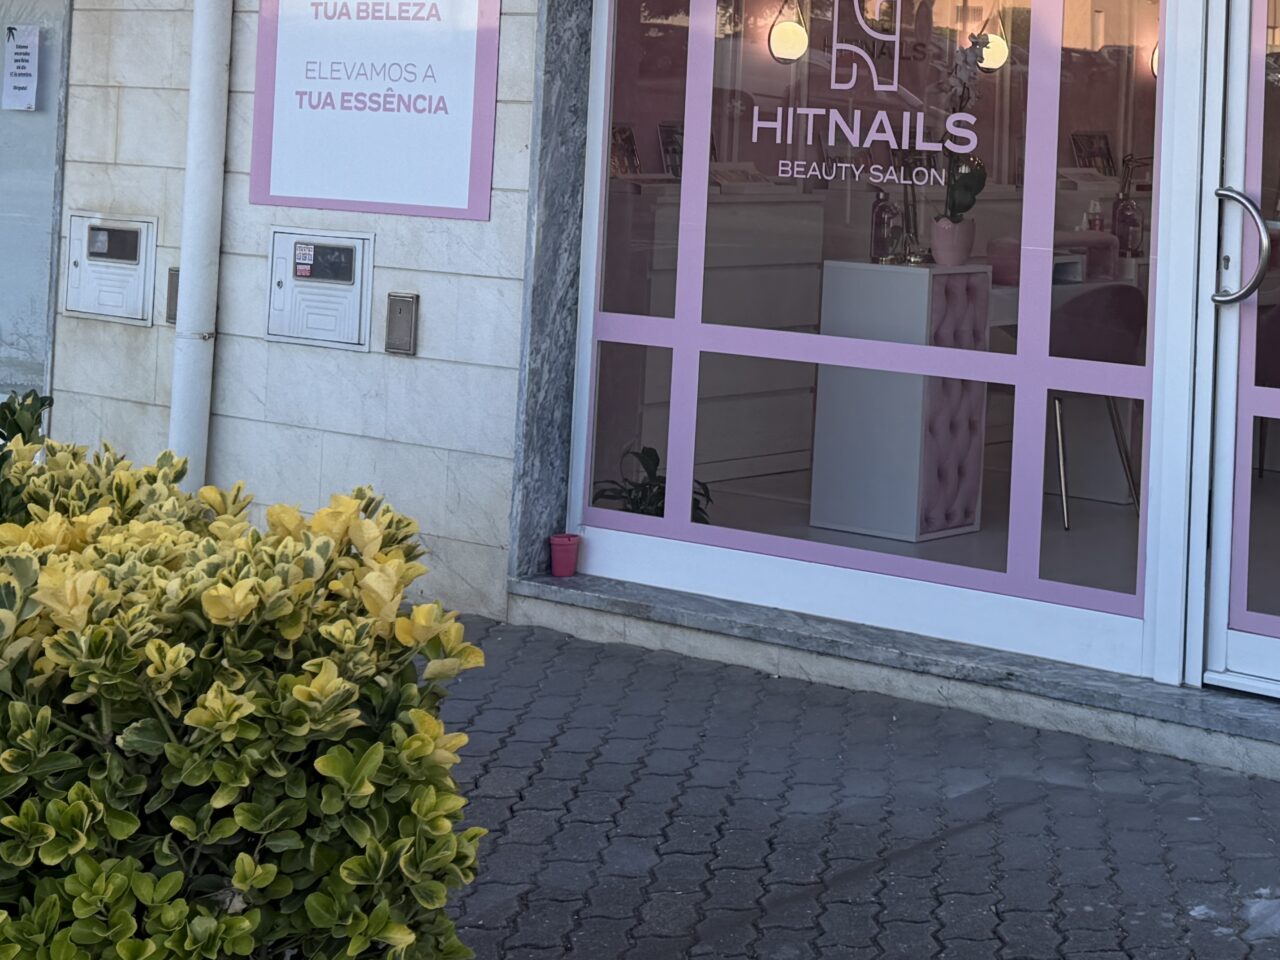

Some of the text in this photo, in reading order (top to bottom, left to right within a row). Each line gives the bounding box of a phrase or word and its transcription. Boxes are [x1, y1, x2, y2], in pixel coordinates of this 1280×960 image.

[310, 2, 441, 22] TUA BELEZA
[305, 61, 437, 83] ELEVAMOS A
[295, 87, 449, 115] TUA ESSÊNCIA
[752, 106, 978, 154] HITNAILS
[778, 160, 945, 186] BEAUTY SALON
